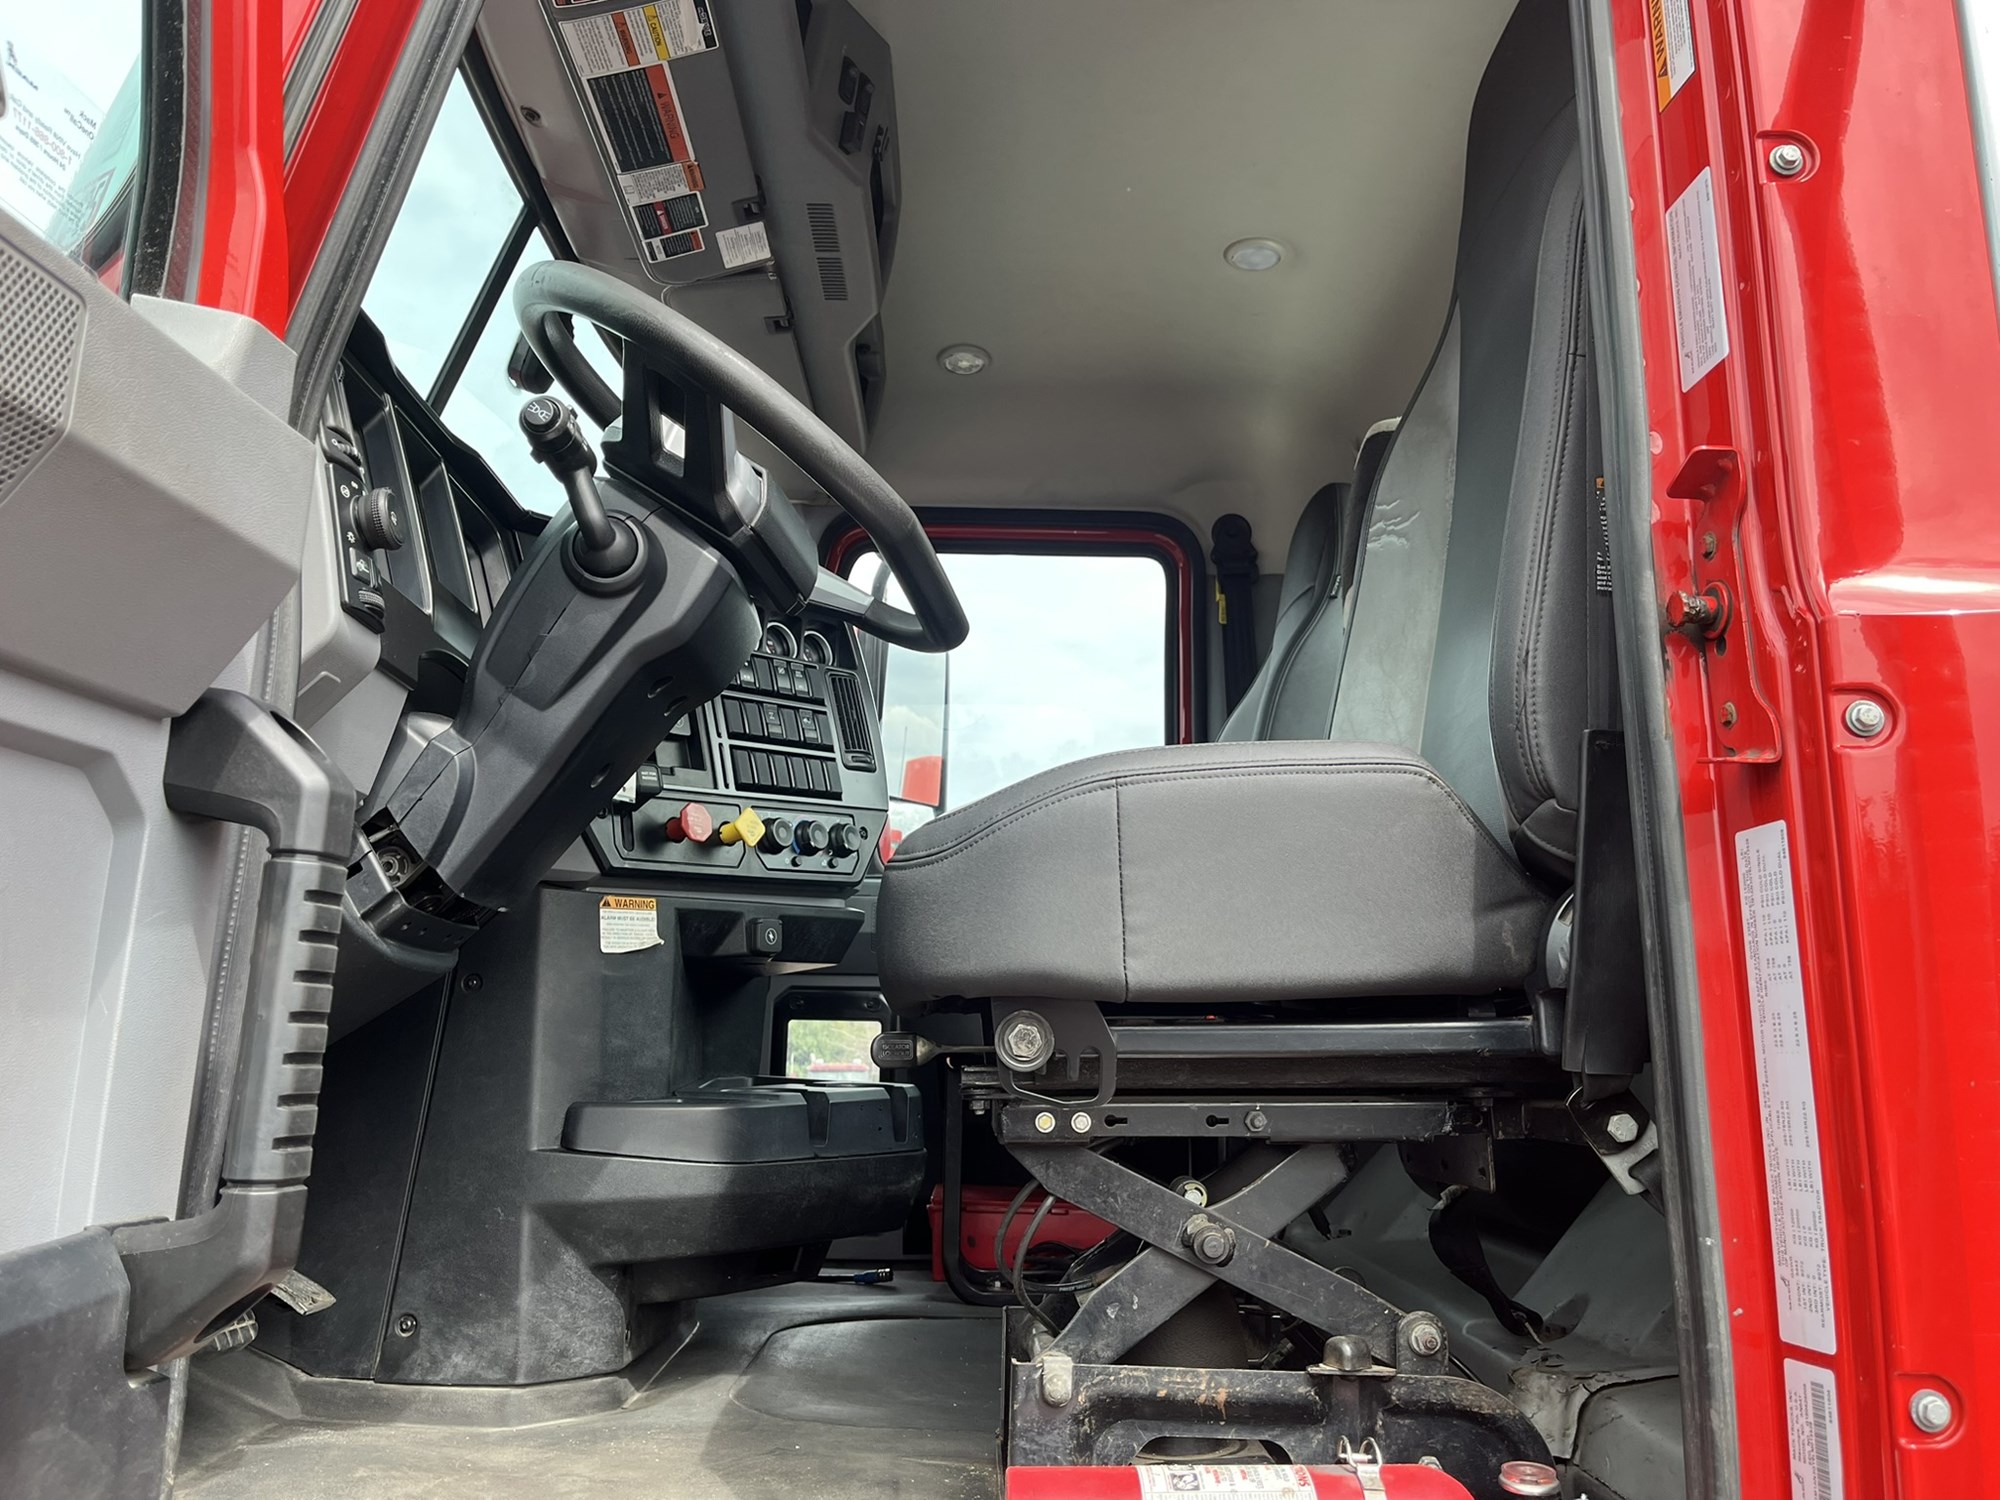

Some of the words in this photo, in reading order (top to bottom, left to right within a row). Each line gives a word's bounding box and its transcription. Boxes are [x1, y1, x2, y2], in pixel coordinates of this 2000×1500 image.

[620, 28, 632, 55] WARNING
[650, 22, 662, 46] CAUTION
[662, 103, 679, 139] WARNING
[615, 899, 655, 909] WARNING
[1773, 1207, 1781, 1266] MANUFACTURED
